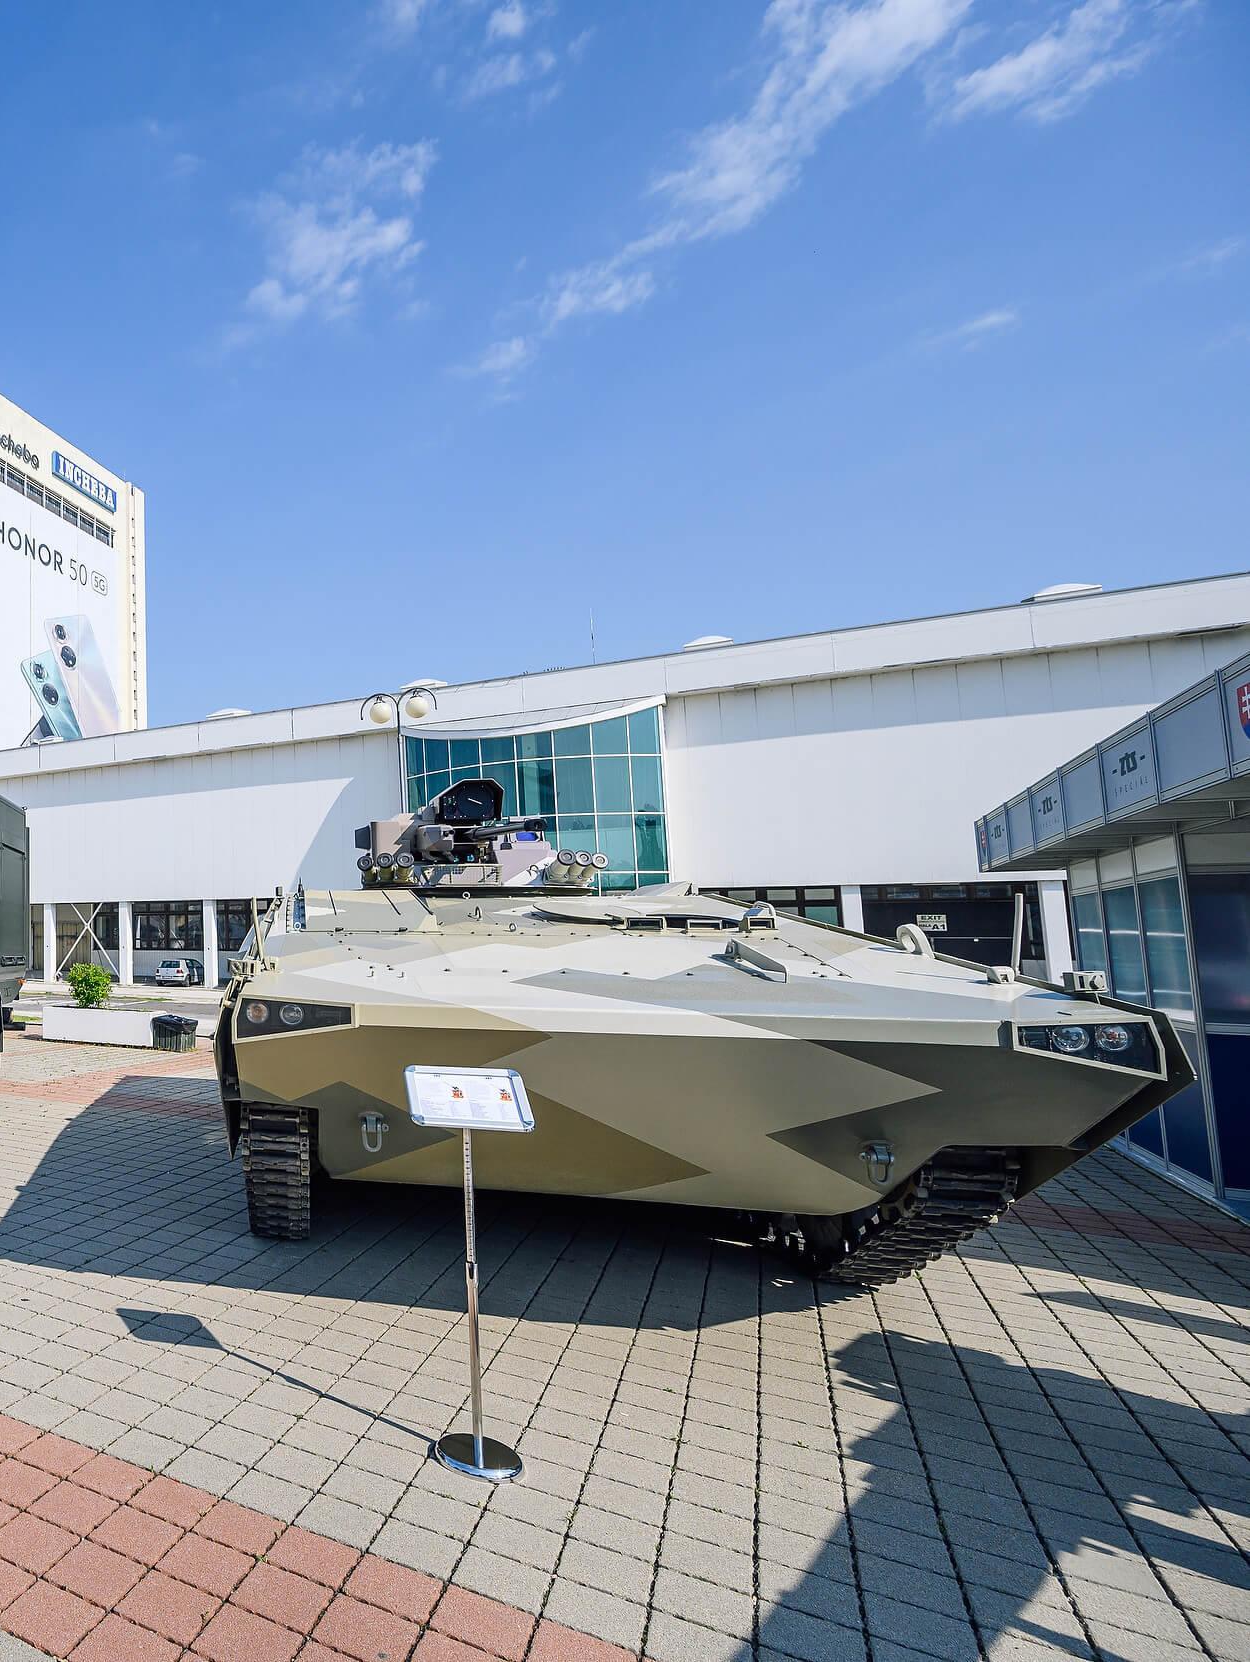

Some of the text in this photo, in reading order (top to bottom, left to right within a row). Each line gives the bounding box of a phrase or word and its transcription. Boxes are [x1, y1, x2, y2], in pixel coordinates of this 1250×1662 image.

[57, 455, 115, 508] INCHEBA
[69, 558, 88, 586] 50
[93, 575, 106, 593] 5G
